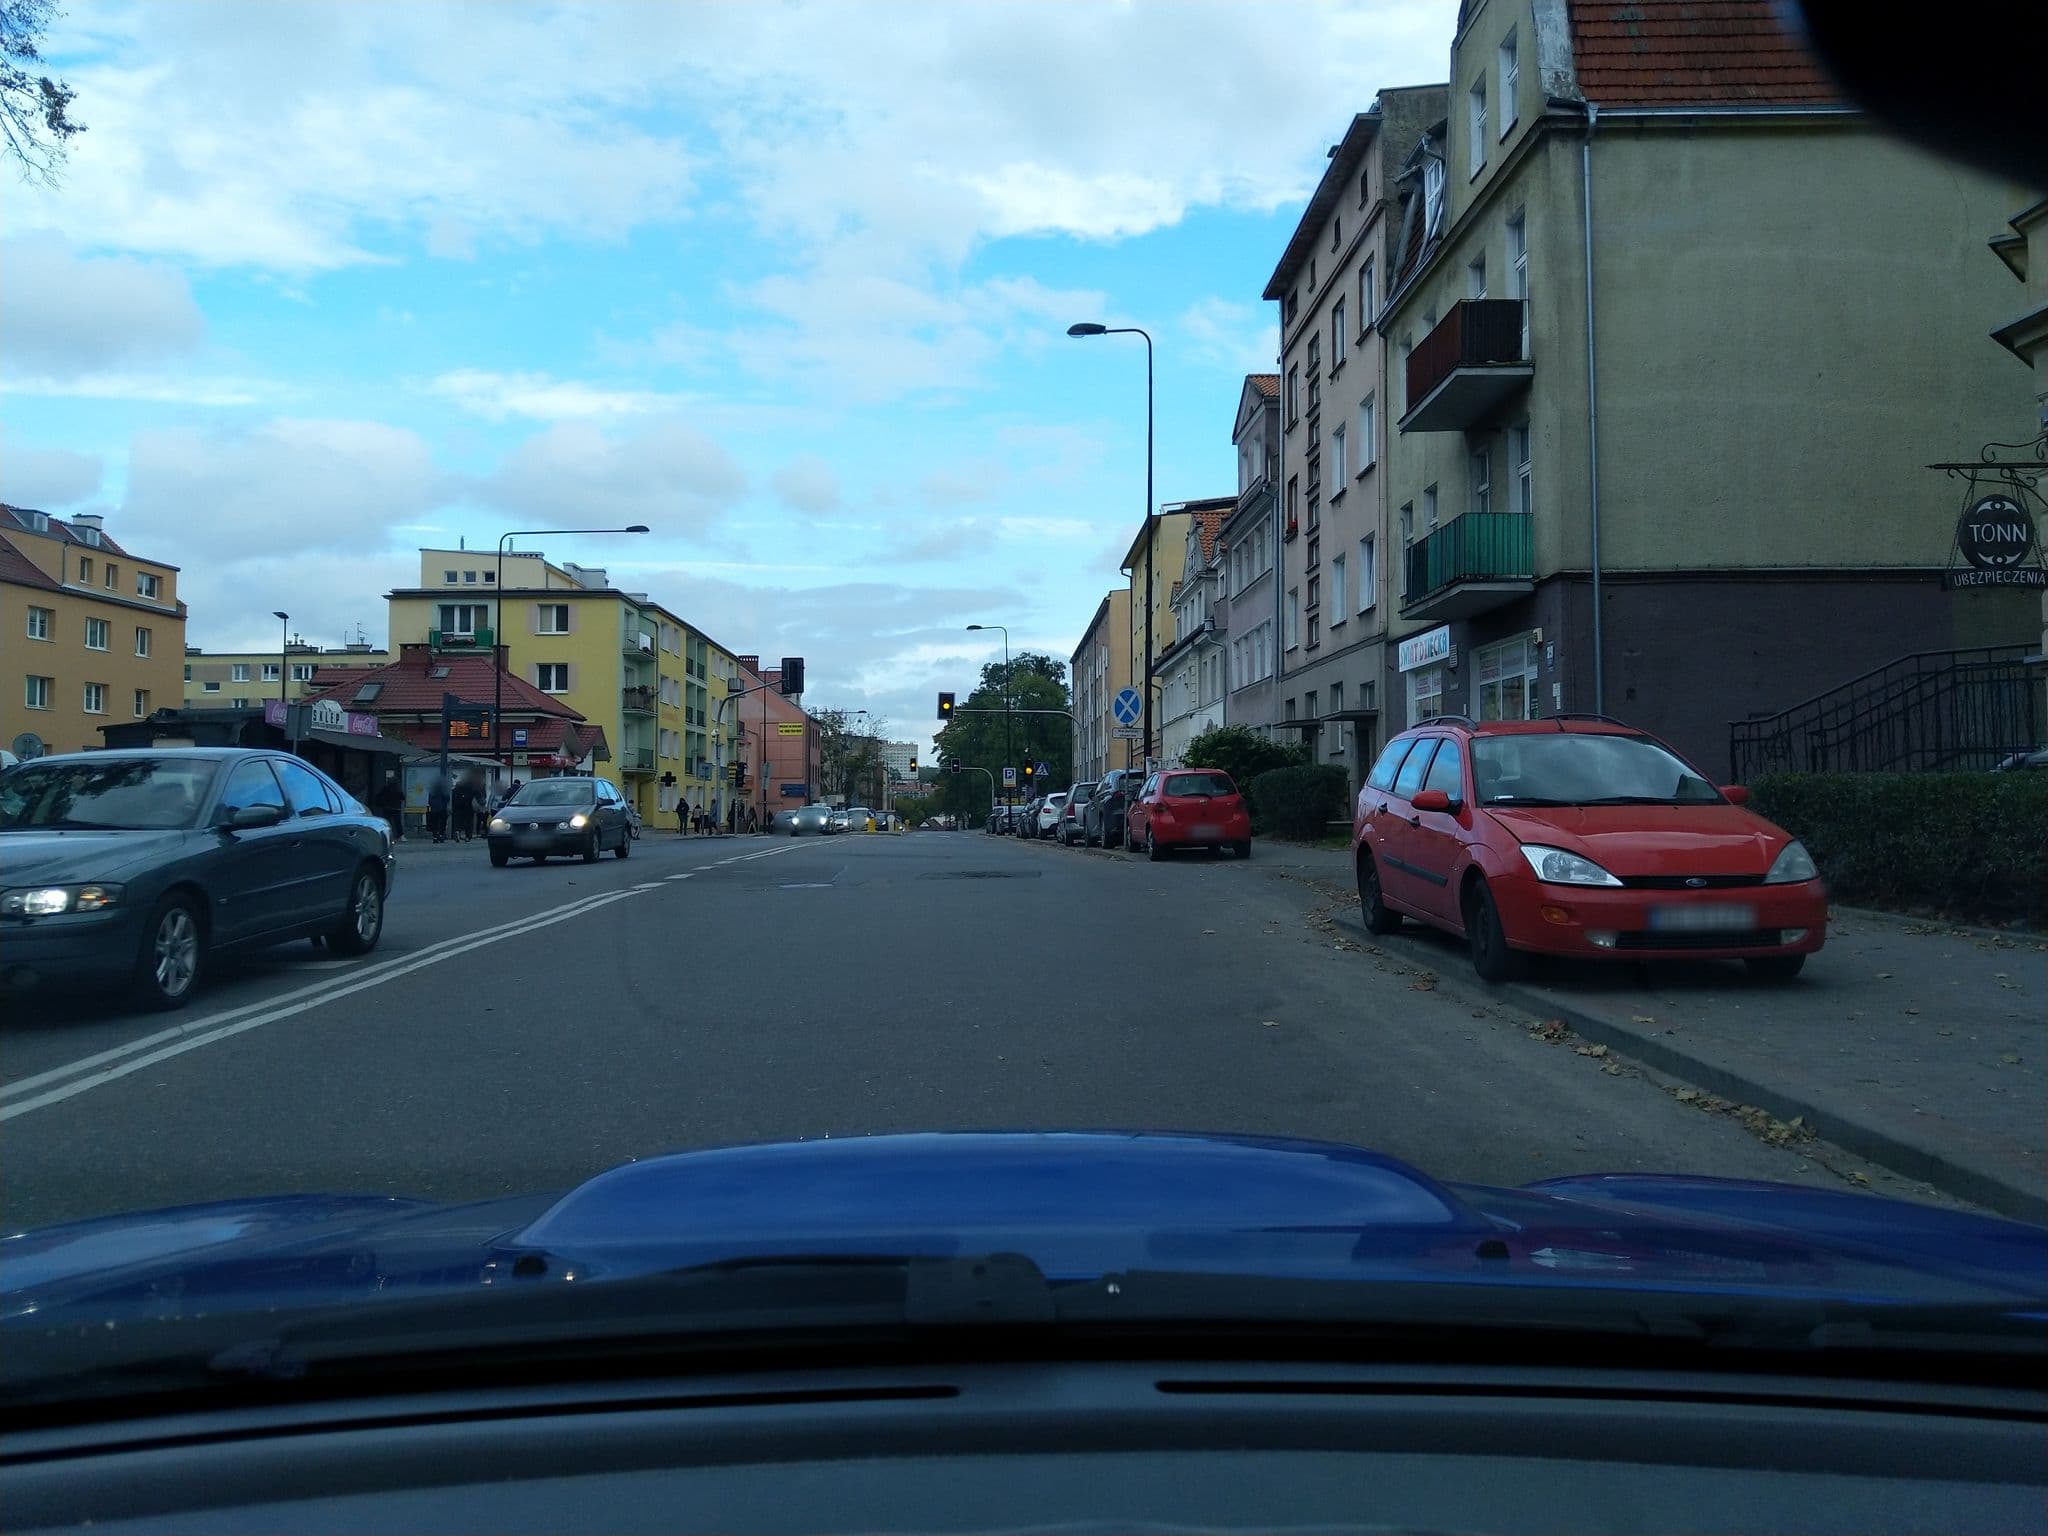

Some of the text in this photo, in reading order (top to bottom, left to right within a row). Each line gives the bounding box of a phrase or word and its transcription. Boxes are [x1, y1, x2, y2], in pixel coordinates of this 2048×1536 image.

[1968, 523, 2027, 543] TONN
[1953, 571, 2046, 586] UBEZPIECZENIA
[313, 709, 340, 724] SKLEP
